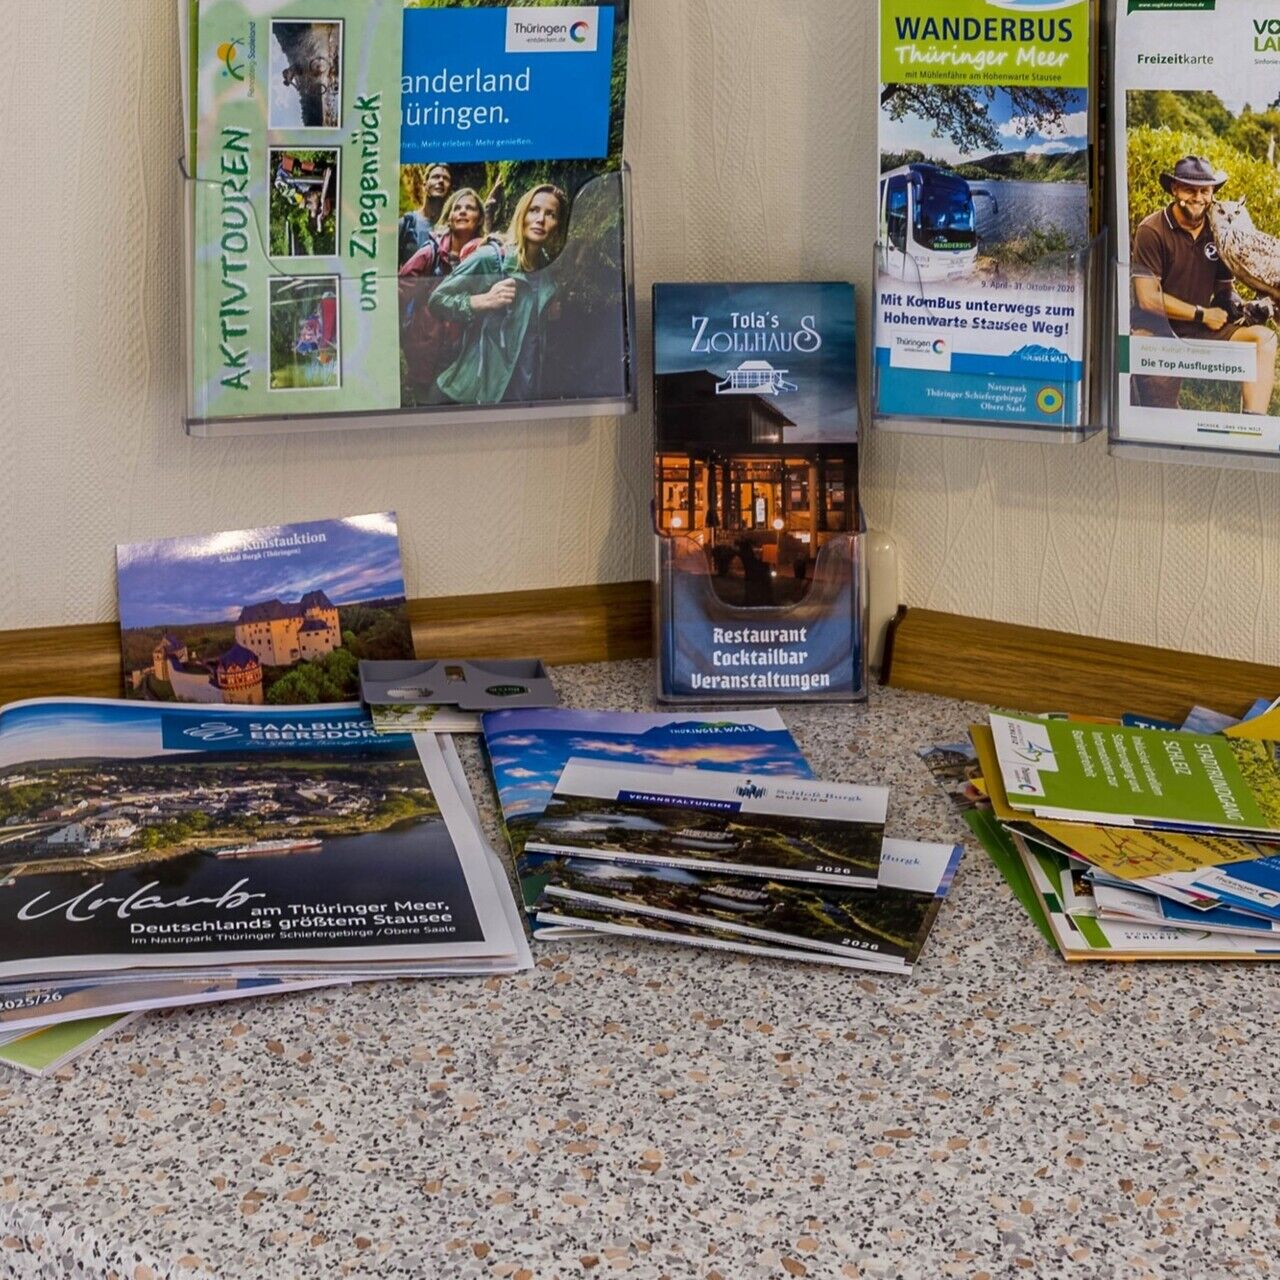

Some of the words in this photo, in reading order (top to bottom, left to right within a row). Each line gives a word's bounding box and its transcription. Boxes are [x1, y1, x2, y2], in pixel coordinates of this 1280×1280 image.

[514, 23, 567, 36] Thüringen
[895, 17, 1073, 42] WANDERBUS
[894, 44, 1008, 71] Thüringer
[1016, 46, 1069, 67] Meer
[1137, 54, 1214, 65] Freizeitkarte
[401, 67, 530, 94] anderland
[421, 140, 440, 148] Mehr
[443, 139, 473, 147] erleben.
[496, 138, 534, 147] genießen.
[349, 92, 388, 261] Ziegenrück
[219, 126, 251, 391] AKTIVTOUREN
[360, 270, 378, 312] um
[881, 293, 902, 306] Mit
[906, 295, 961, 310] KomBus
[965, 301, 1040, 316] unterwegs
[1045, 306, 1075, 316] zum
[691, 315, 821, 353] ZOLLHAUS
[883, 312, 967, 329] Hohenwarte
[972, 317, 1028, 332] Stausee
[1032, 321, 1069, 338] Weg!
[1141, 358, 1157, 368] Die
[1159, 360, 1177, 370] Top
[1178, 361, 1246, 374] Ausflugstipps.
[243, 531, 327, 552] Kunstauktion
[713, 628, 807, 644] Restaurant
[713, 649, 808, 666] Cocktailbar
[691, 672, 831, 691] Veranstaltungen
[629, 794, 731, 809] VERANSTALTUNGEN
[816, 865, 851, 874] 2026
[17, 877, 265, 922] Urlaub
[251, 906, 282, 916] am
[288, 903, 388, 916] Thüringer
[394, 900, 449, 911] Meer,
[130, 920, 271, 934] Deutschlands
[279, 915, 367, 930] größtem
[373, 912, 453, 925] Stausee
[131, 937, 148, 945] im
[150, 934, 213, 945] Naturpark
[216, 931, 276, 942] Thüringer
[279, 929, 373, 941] Schiefergebirge
[383, 927, 420, 936] Obere
[424, 925, 456, 934] Saale
[841, 938, 879, 951] 2026
